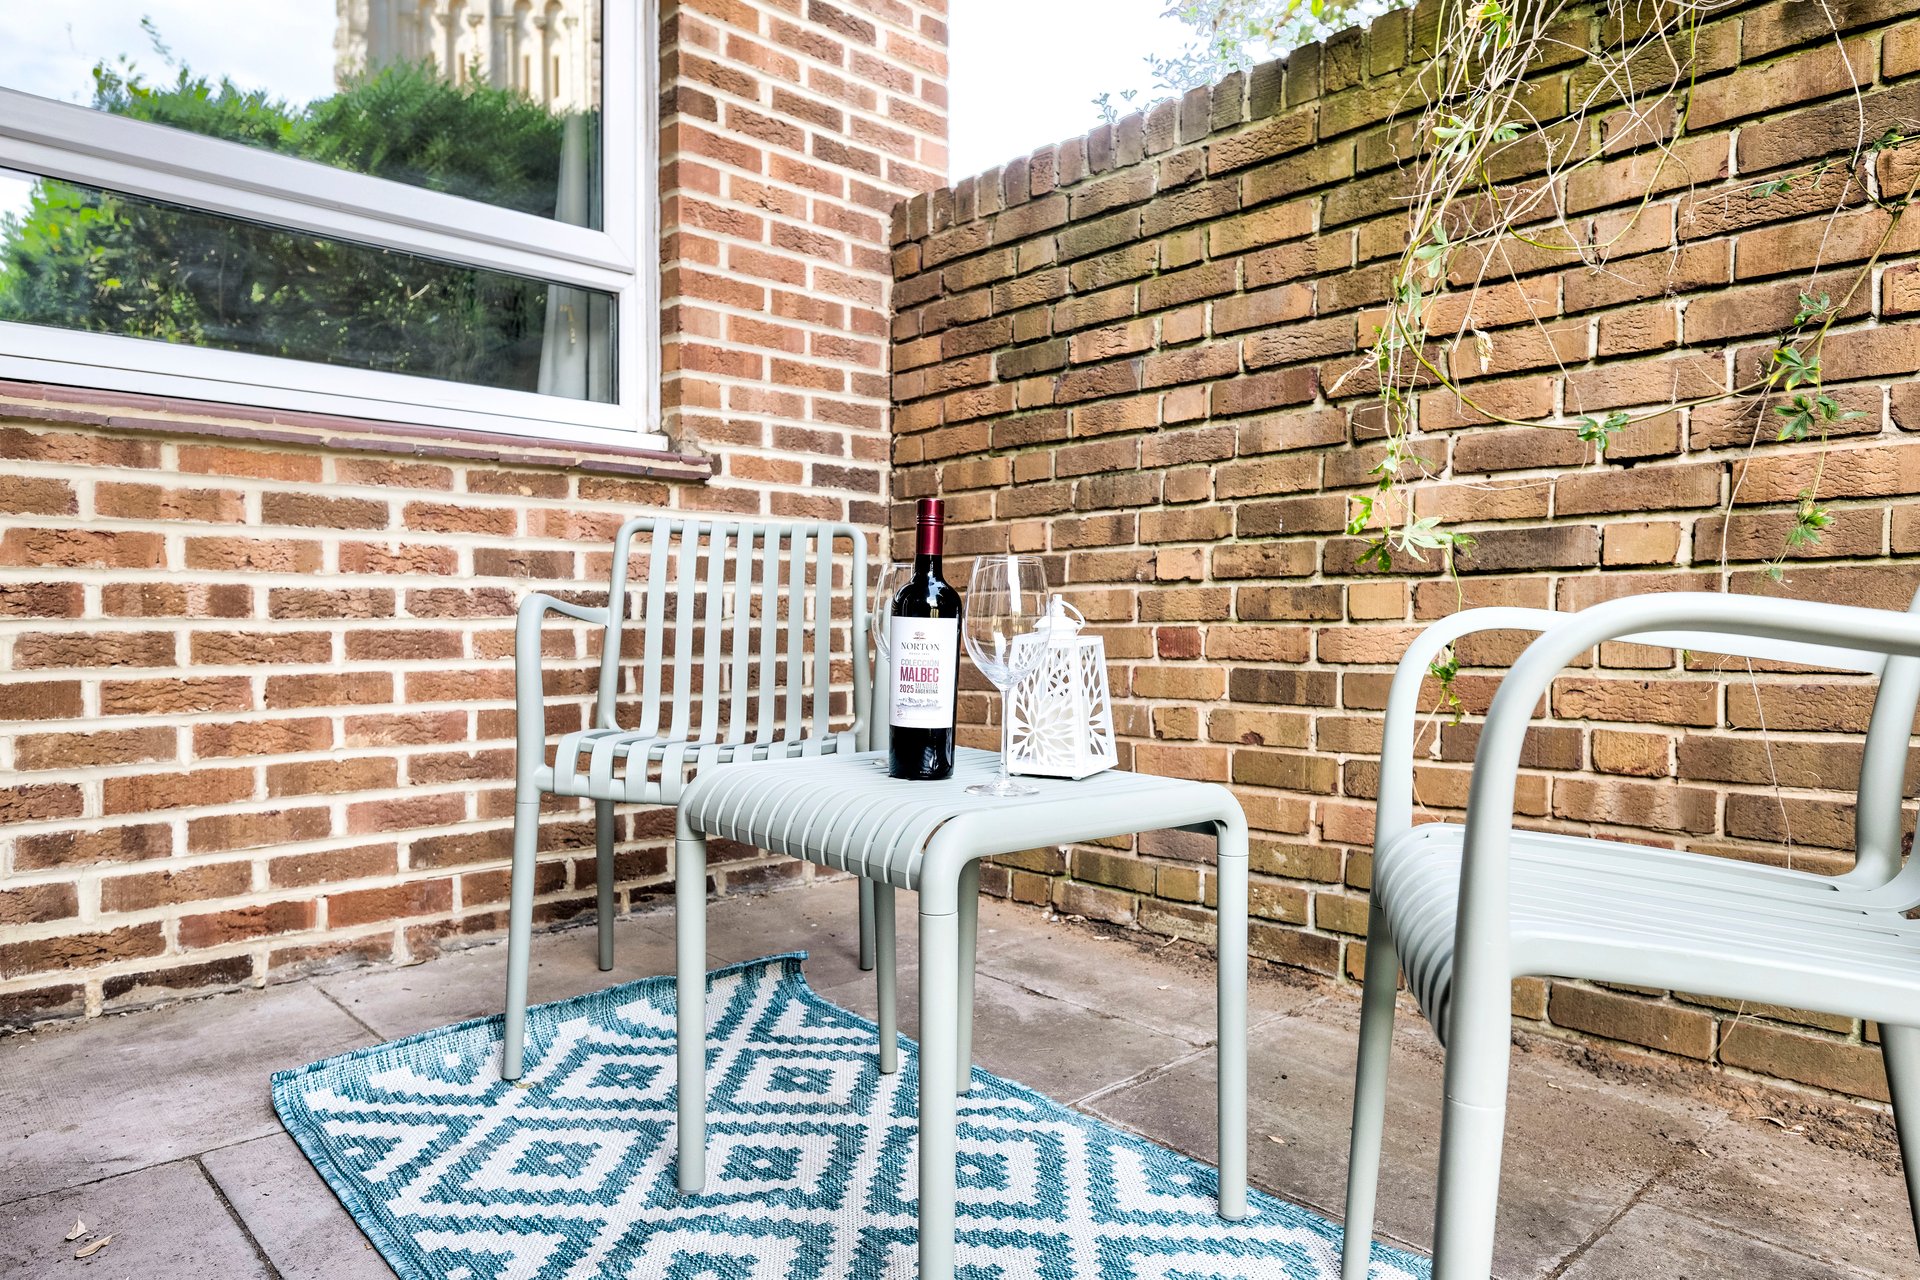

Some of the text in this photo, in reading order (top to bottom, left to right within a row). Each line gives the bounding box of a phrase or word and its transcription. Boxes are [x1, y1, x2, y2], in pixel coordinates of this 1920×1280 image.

[901, 642, 940, 651] NORTON
[900, 666, 939, 683] MALBEC
[899, 684, 915, 694] 2025
